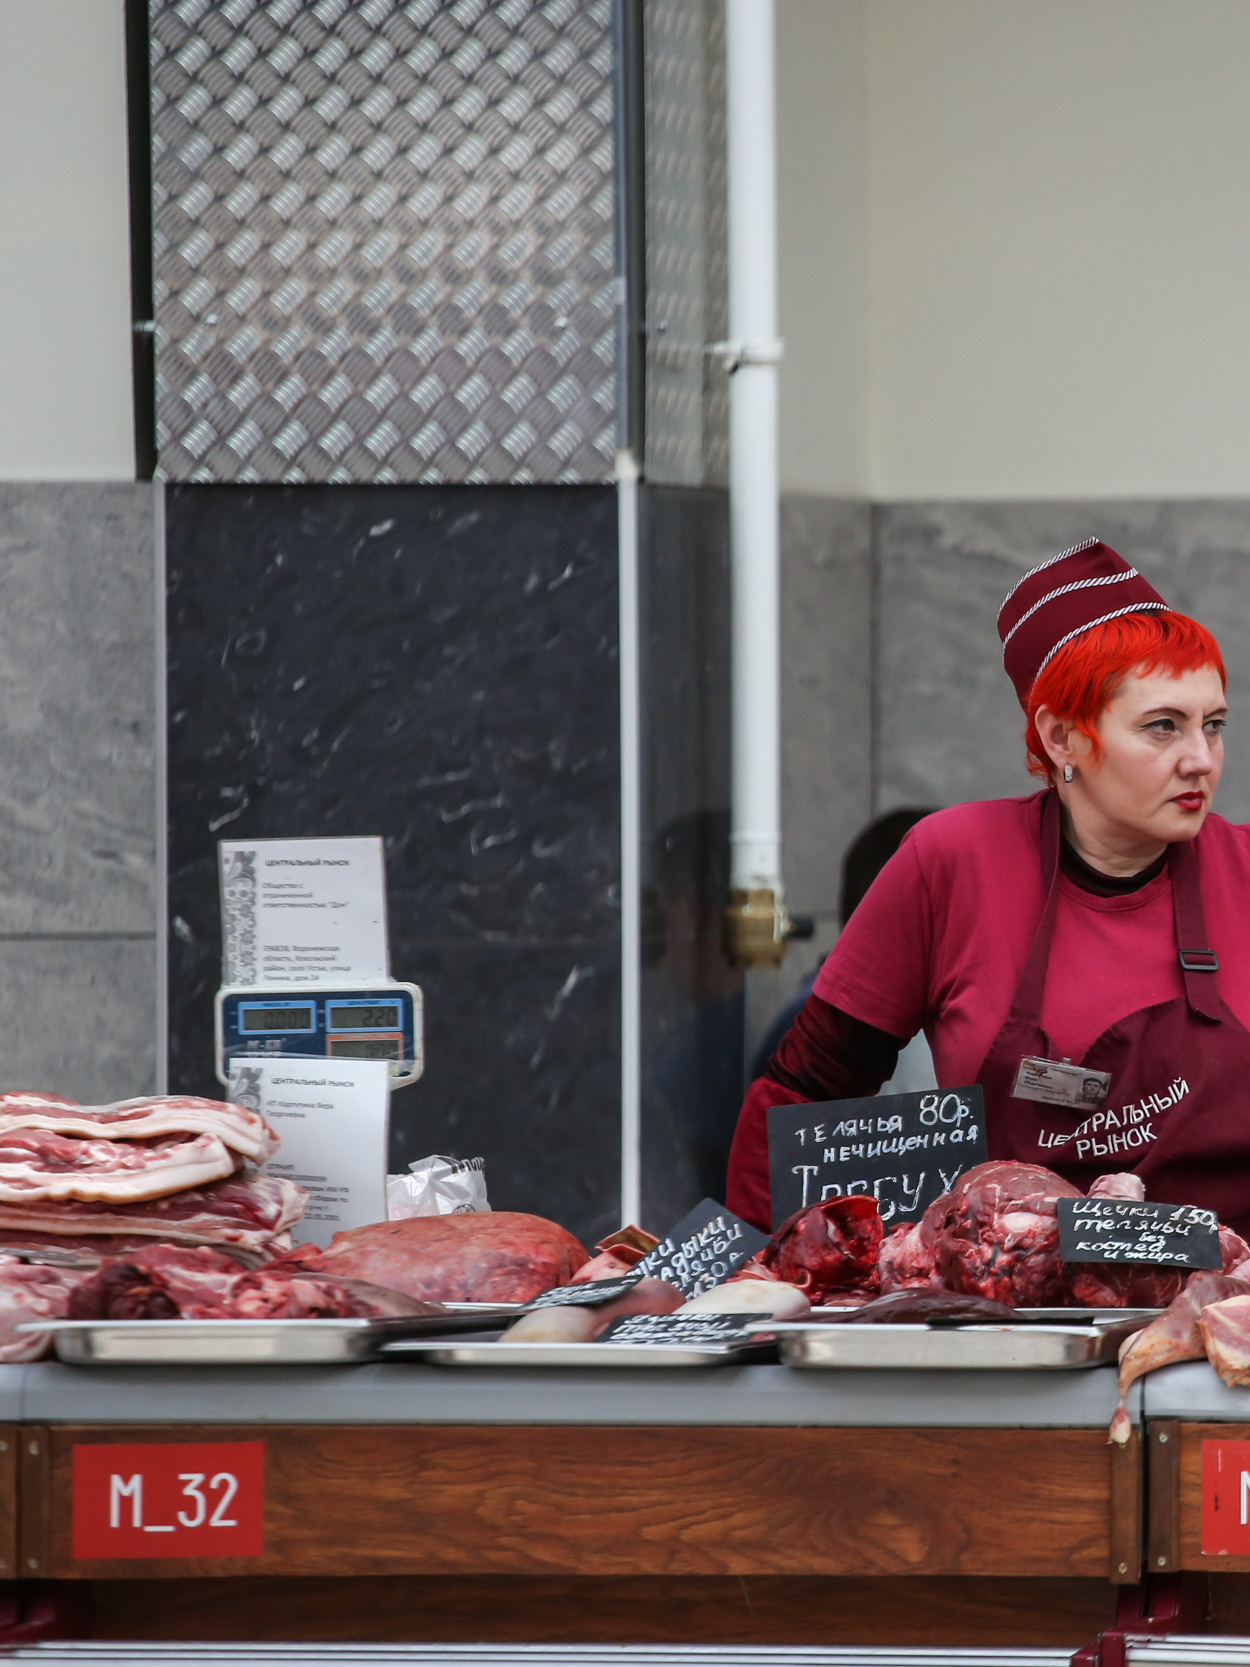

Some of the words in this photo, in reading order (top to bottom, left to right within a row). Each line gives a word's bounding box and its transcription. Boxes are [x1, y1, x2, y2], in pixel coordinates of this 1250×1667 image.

[265, 859, 321, 868] ЦЕНТРАЛЬНЫЙ
[262, 891, 313, 899] ограниченной
[262, 901, 326, 909] ответственностью
[292, 945, 340, 953] Воронежская
[270, 1078, 326, 1086] ЦЕНТРАЛЬНЫЙ
[328, 1080, 355, 1088] РЫНОК
[1076, 1122, 1157, 1160] РЫНОК
